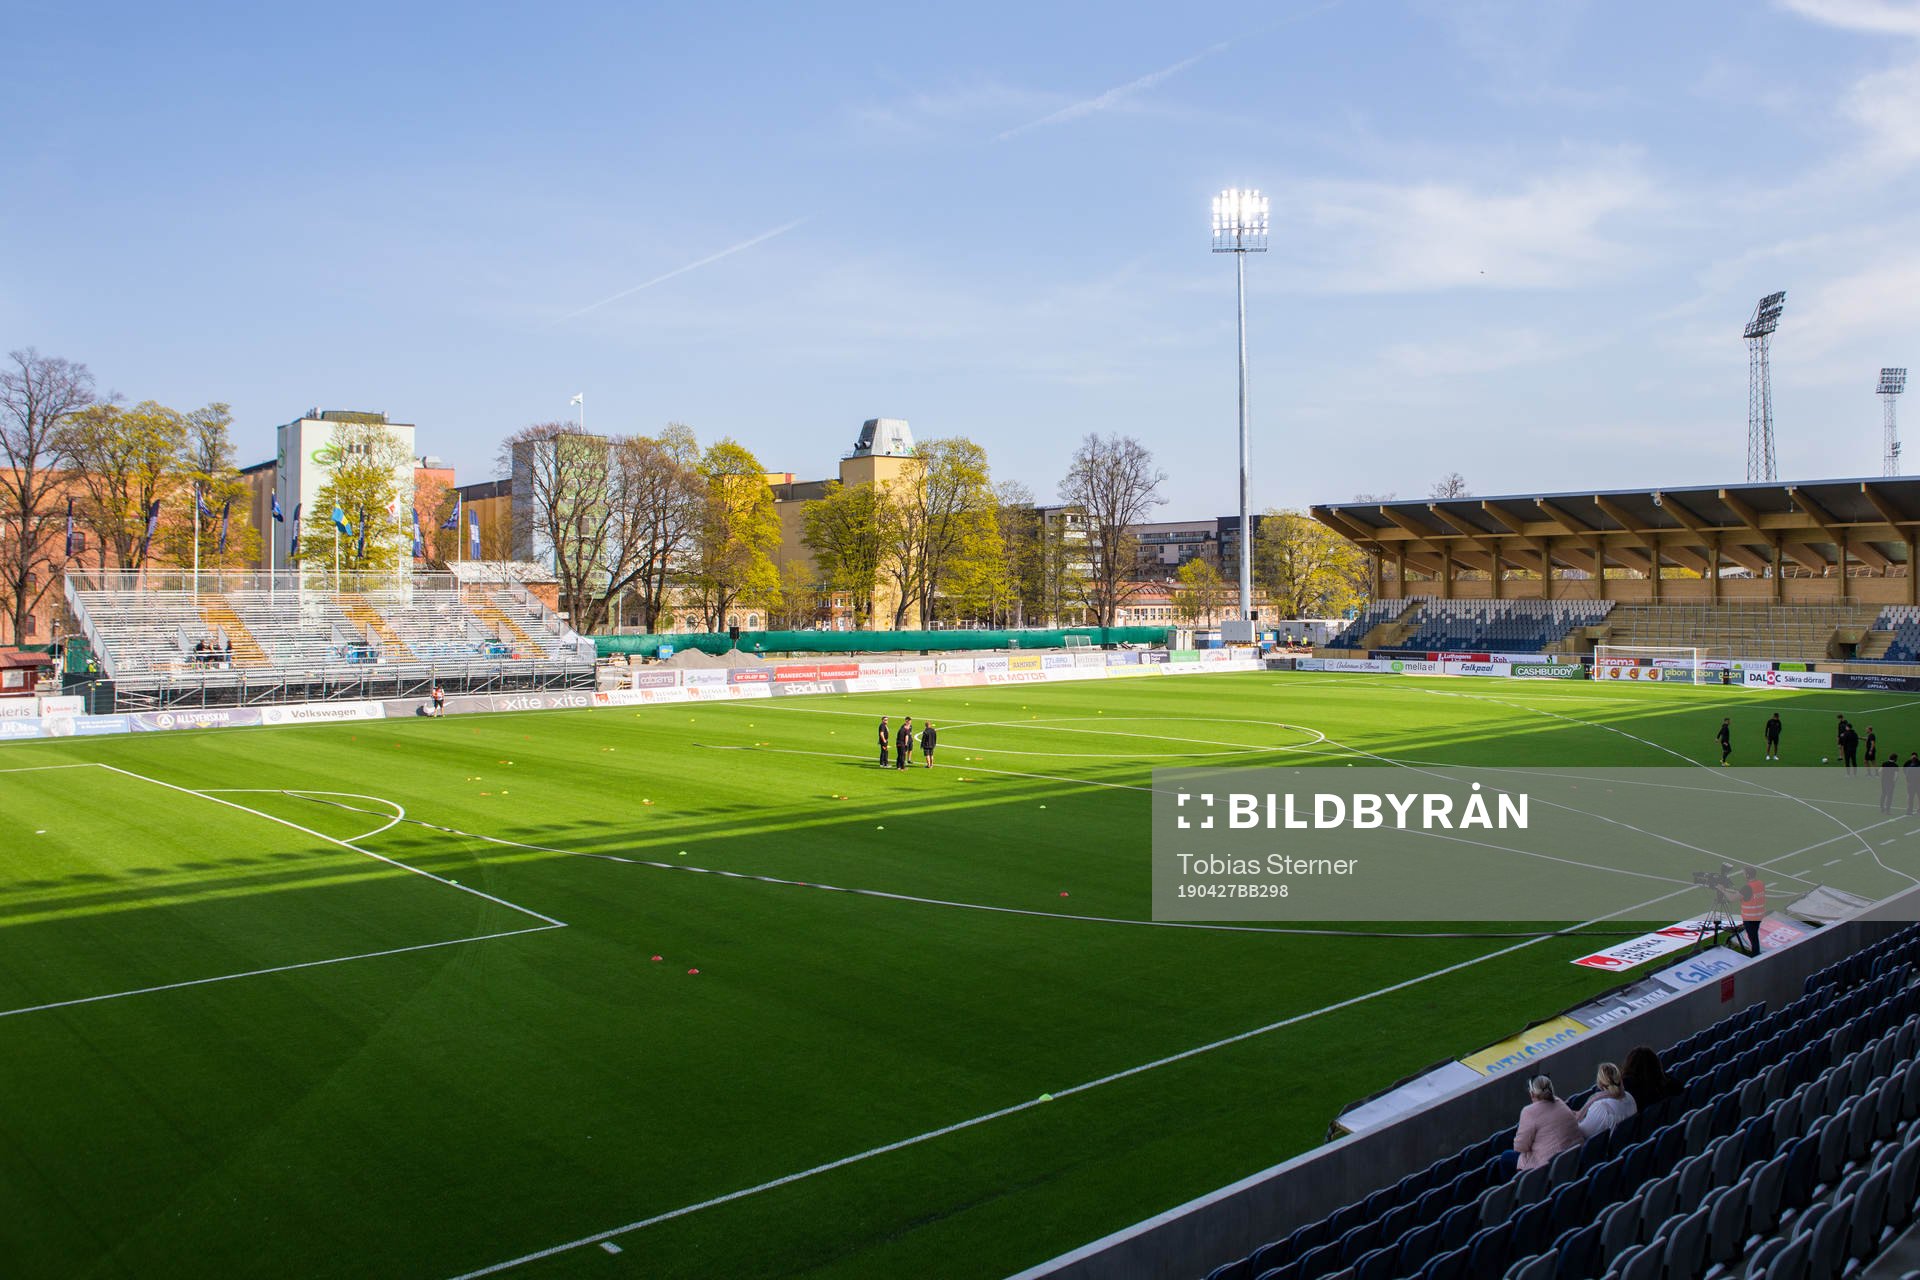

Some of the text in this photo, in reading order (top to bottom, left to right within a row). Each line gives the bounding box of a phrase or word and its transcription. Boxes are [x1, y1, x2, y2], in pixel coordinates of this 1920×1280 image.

[1007, 672, 1048, 681] MOTOR
[1516, 665, 1573, 677] CASHBUDDY
[1664, 669, 1687, 680] gibon
[1749, 672, 1782, 684] DALOC
[783, 681, 834, 695] stadium
[505, 696, 542, 711] xite
[552, 693, 588, 708] xite
[0, 704, 31, 717] leris
[291, 708, 357, 719] Volkswagen
[176, 711, 230, 724] ALLSVENSKAN
[1609, 938, 1668, 959] SVENSKA
[1627, 949, 1663, 963] SPEL
